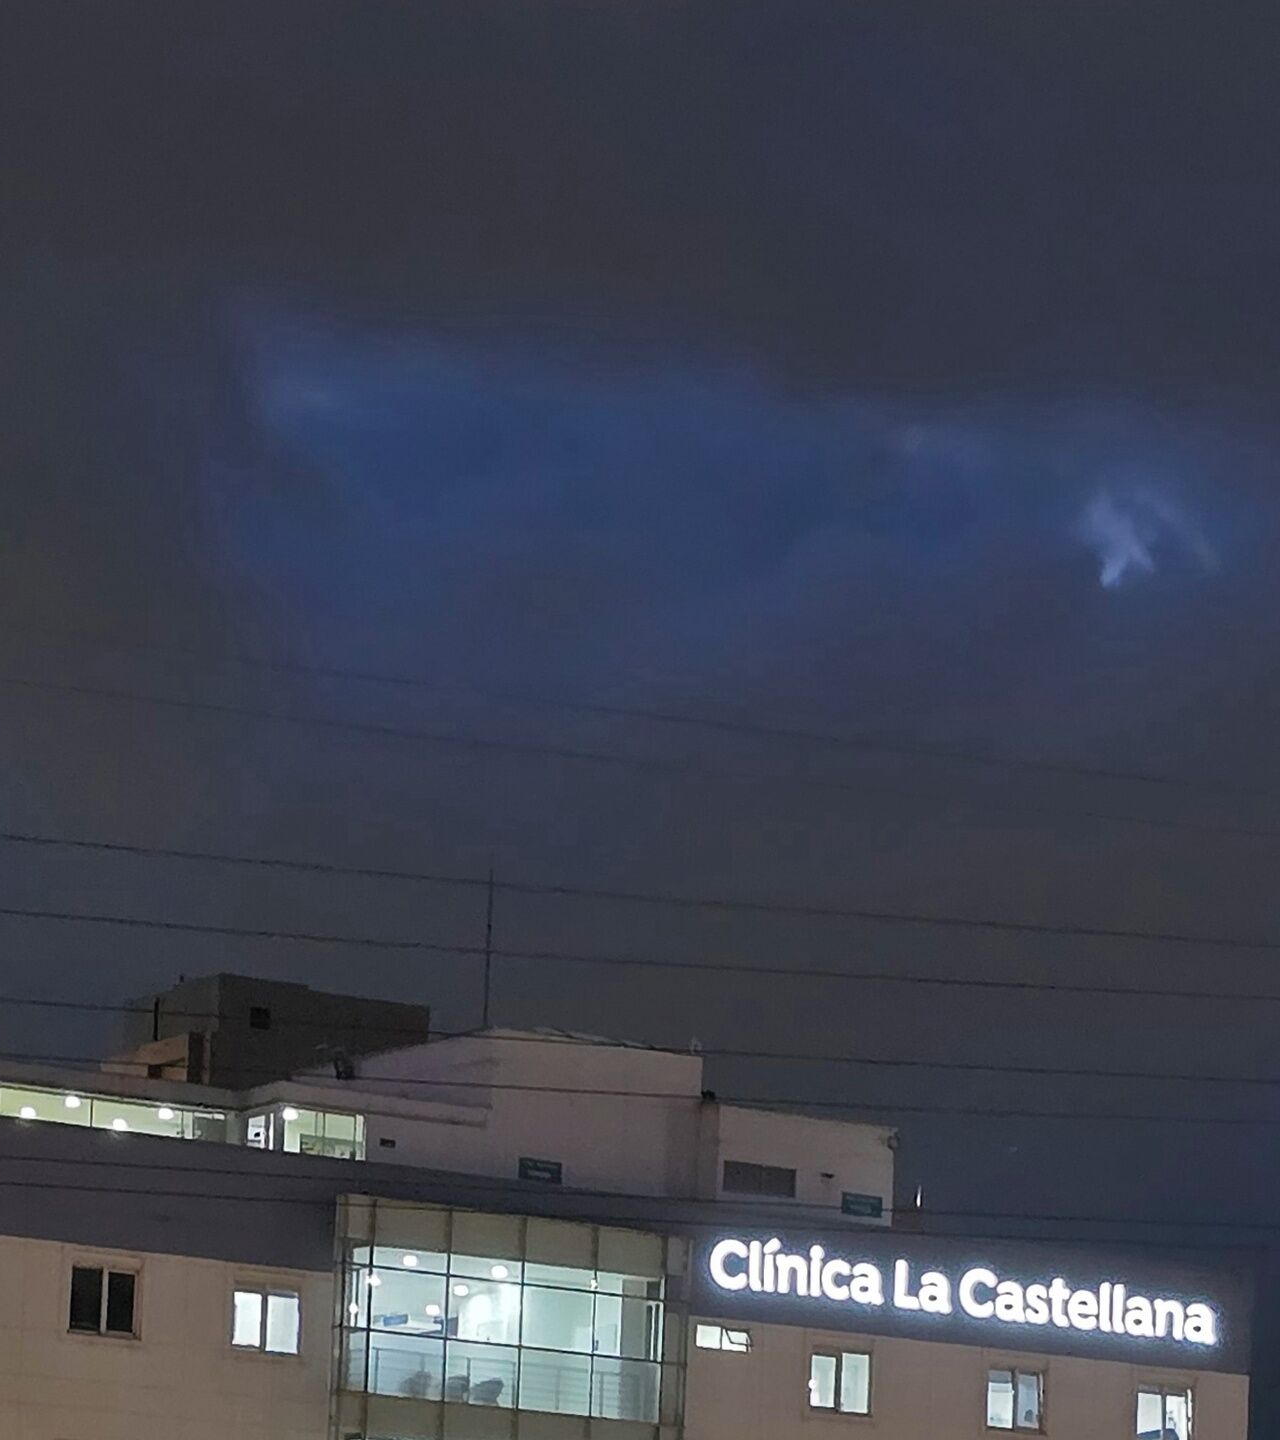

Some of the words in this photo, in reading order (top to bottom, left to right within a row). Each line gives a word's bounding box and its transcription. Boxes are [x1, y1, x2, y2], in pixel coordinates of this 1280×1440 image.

[709, 1238, 884, 1306] Clínica
[893, 1260, 952, 1314] La
[959, 1268, 1216, 1344] Castellana
